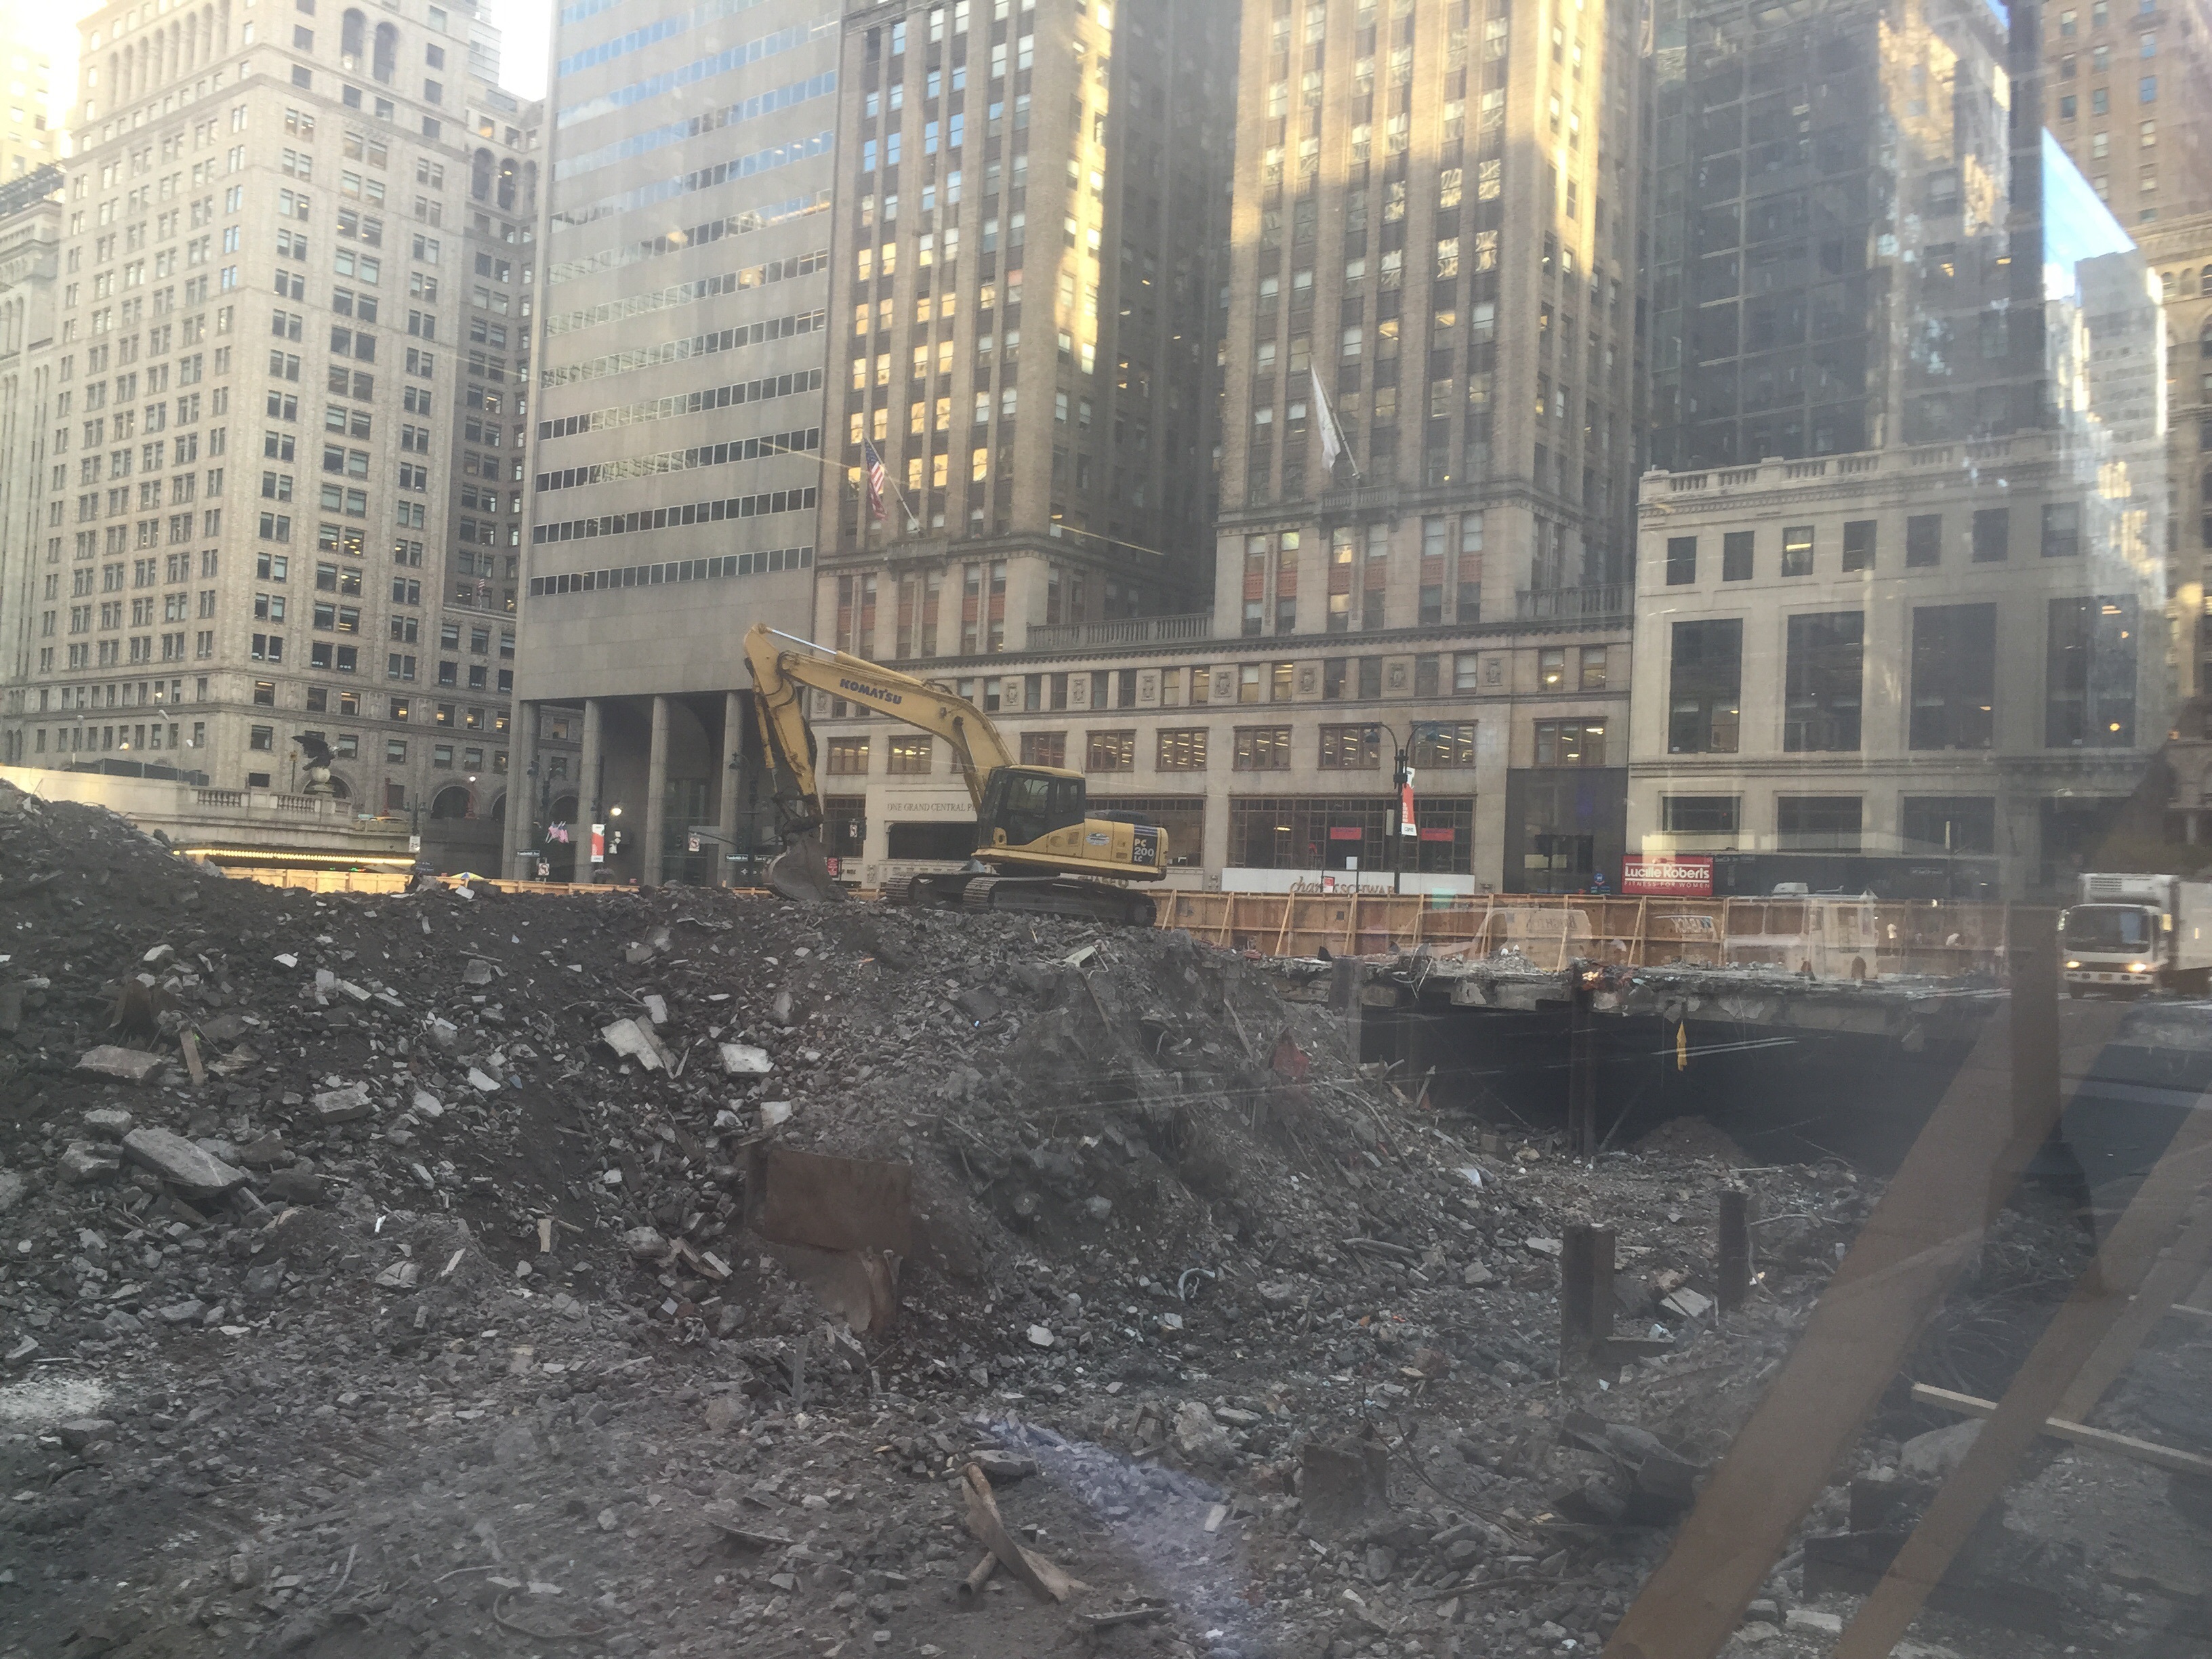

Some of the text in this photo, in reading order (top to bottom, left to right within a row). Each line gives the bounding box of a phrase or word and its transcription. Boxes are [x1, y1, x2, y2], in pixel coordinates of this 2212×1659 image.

[840, 678, 902, 704] KOMATSU
[887, 803, 902, 811] ONE
[904, 803, 930, 811] GRAND
[931, 803, 965, 811] CENTRAL
[1134, 838, 1147, 847] PC
[1134, 846, 1155, 857] 200
[1625, 865, 1710, 879] Lucille Roberts
